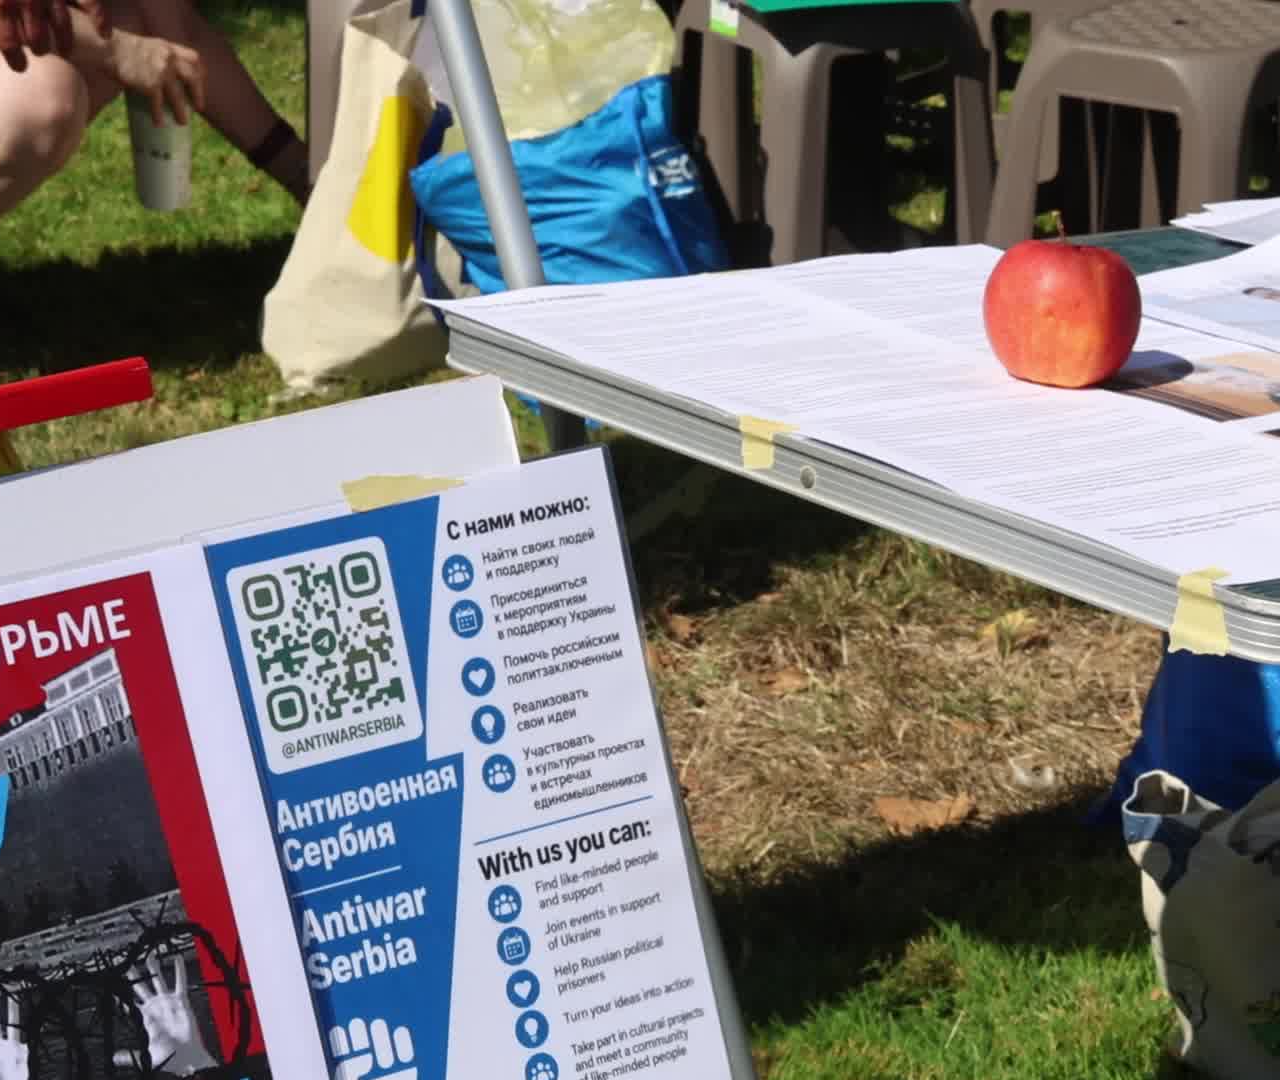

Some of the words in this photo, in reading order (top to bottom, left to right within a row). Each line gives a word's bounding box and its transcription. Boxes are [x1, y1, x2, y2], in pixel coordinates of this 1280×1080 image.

[447, 520, 460, 540] С
[465, 512, 515, 537] нами
[520, 496, 591, 525] можно:
[482, 547, 518, 564] Найти
[521, 538, 555, 556] своих
[559, 528, 595, 546] людей
[486, 572, 493, 580] и
[495, 554, 560, 577] поддержку
[490, 576, 588, 608] Присоединиться
[495, 615, 501, 623] к
[503, 593, 587, 621] мероприятиям
[497, 631, 504, 640] в
[507, 615, 567, 639] поддержку
[570, 605, 616, 624] Украины
[503, 649, 549, 669] Помочь
[551, 632, 620, 659] российским
[507, 648, 623, 685] политзаключенным
[513, 688, 589, 714] Реализовать
[281, 714, 406, 759] @ANTIWARSERBIA
[517, 716, 545, 732] свои
[522, 734, 595, 760] Участвовать
[526, 766, 533, 776] в
[535, 752, 596, 775] культурных
[598, 738, 645, 760] проектах
[277, 764, 458, 833] Антивоенная
[530, 783, 538, 792] и
[540, 769, 592, 792] встречах
[534, 771, 648, 810] единомышленников
[282, 821, 396, 872] Сербия
[478, 847, 533, 881] With
[536, 844, 563, 865] us
[565, 834, 605, 864] you
[609, 819, 652, 846] can:
[535, 879, 558, 893] Find
[560, 861, 622, 887] like-minded
[624, 850, 659, 870] people
[539, 895, 560, 909] and
[562, 882, 604, 904] support
[544, 920, 568, 935] Join
[570, 910, 606, 928] events
[609, 904, 618, 916] in
[620, 892, 661, 914] support
[302, 886, 426, 947] Antiwar
[547, 936, 559, 951] of
[560, 927, 601, 946] Ukraine
[553, 960, 579, 977] Help
[581, 950, 621, 969] Russian
[624, 936, 664, 959] political
[307, 933, 417, 989] Serbia
[558, 972, 606, 996] prisoners
[563, 1009, 588, 1024] Turn
[589, 1002, 612, 1018] your
[614, 992, 641, 1009] ideas
[571, 1040, 594, 1056] Take
[596, 1033, 617, 1050] part
[618, 1030, 628, 1041] in
[629, 1017, 665, 1038] cultural
[575, 1058, 594, 1072] and
[596, 1048, 622, 1066] meet
[624, 1048, 631, 1056] a
[632, 1030, 689, 1054] community
[652, 1046, 687, 1067] people
